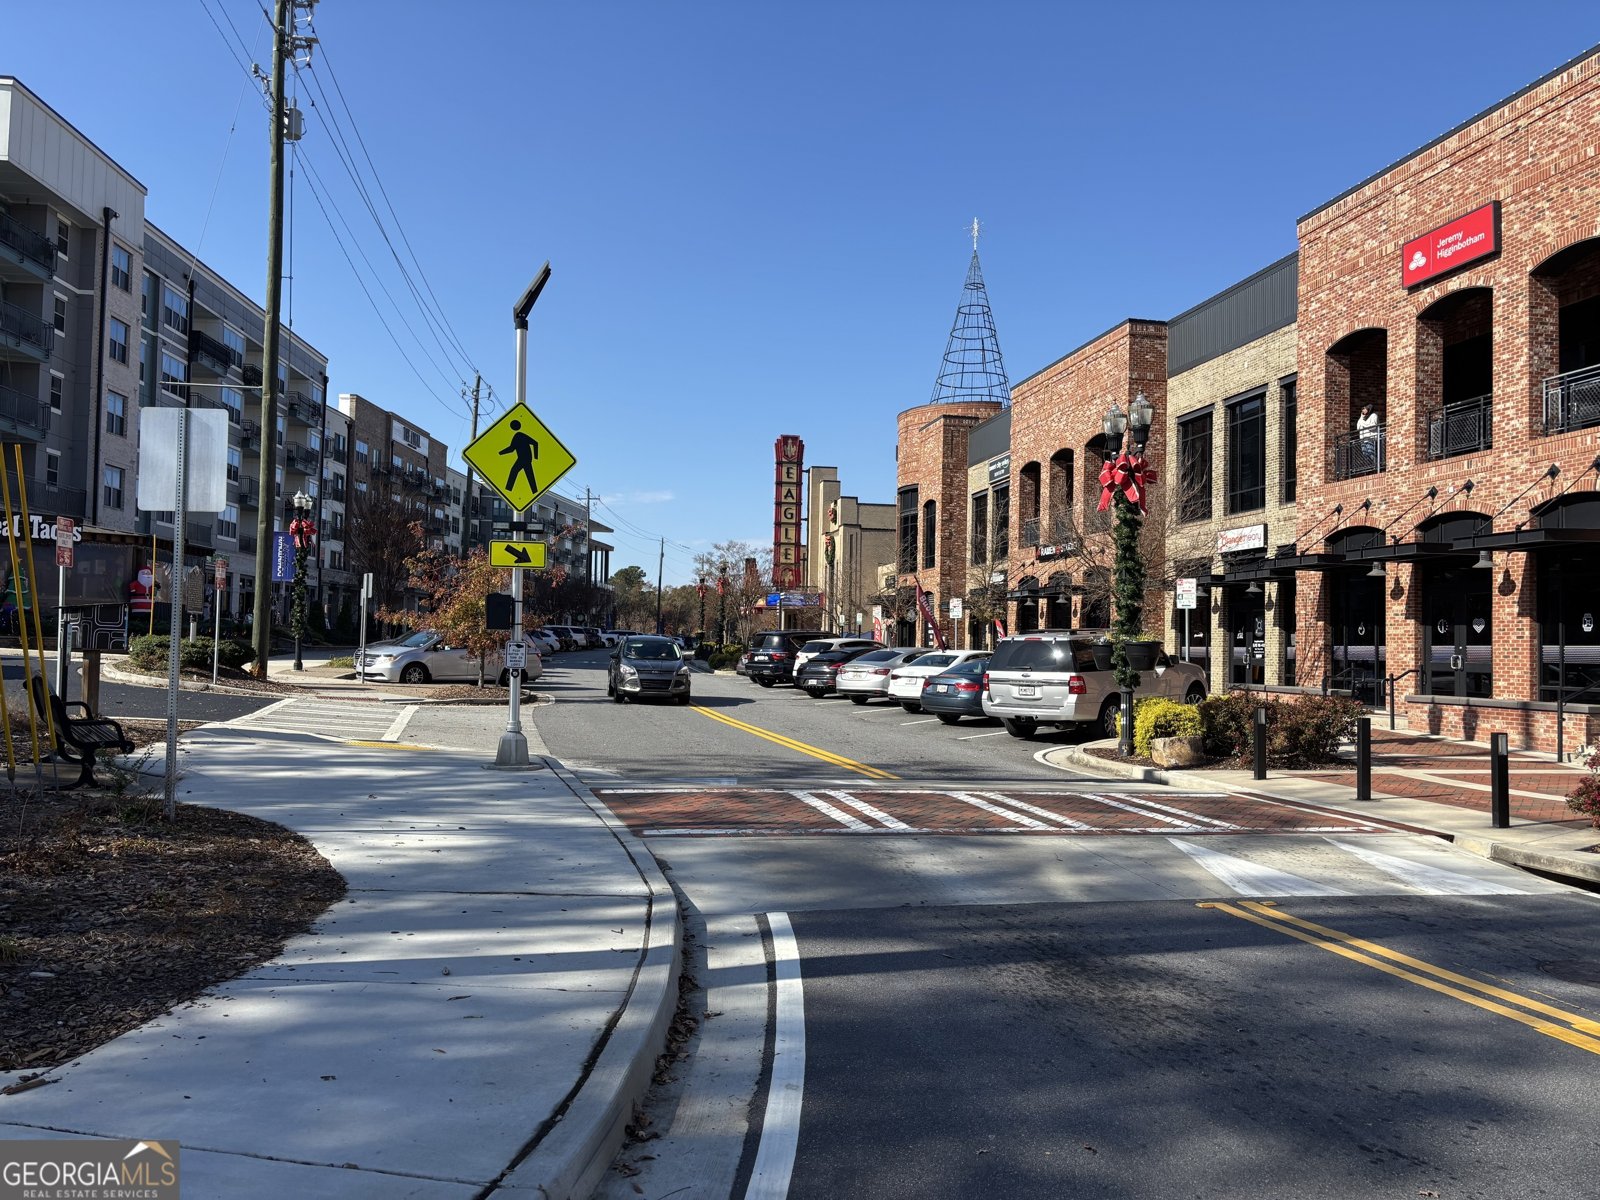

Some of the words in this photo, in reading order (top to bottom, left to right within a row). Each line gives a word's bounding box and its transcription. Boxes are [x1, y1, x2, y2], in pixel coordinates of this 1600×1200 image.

[1437, 231, 1463, 248] Jeremy
[1437, 231, 1485, 259] Higginbotham
[782, 466, 795, 561] EAGLE
[0, 515, 21, 537] al
[29, 514, 82, 542] Tacs
